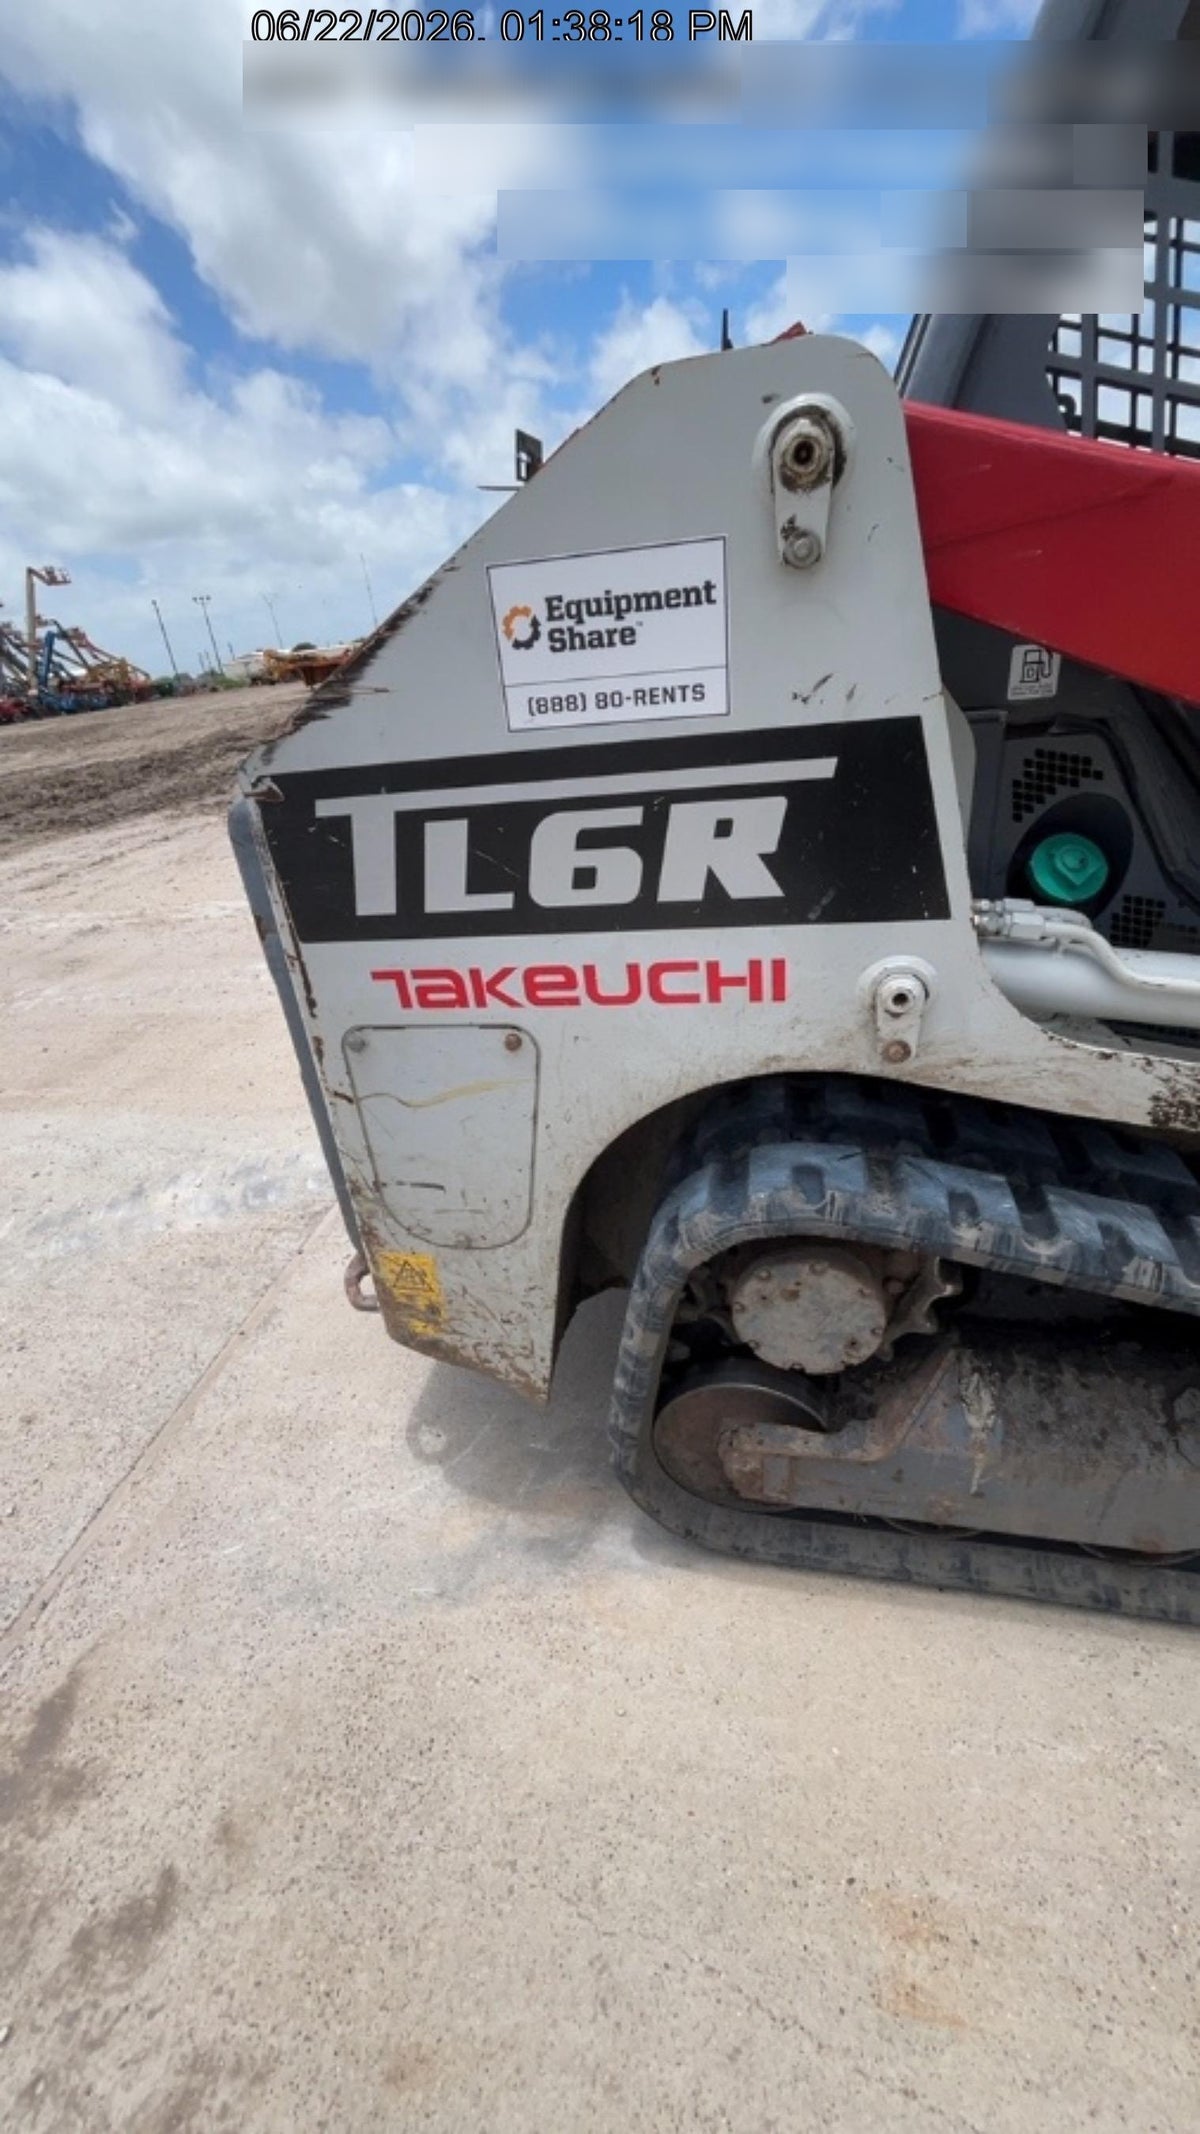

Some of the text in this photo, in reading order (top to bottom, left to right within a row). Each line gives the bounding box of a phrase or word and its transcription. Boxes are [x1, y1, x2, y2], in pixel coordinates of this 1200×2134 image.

[544, 580, 717, 625] Equipment
[548, 625, 637, 653] Share
[527, 683, 706, 717] (888) 80-RENTS
[315, 756, 838, 917] TL6R
